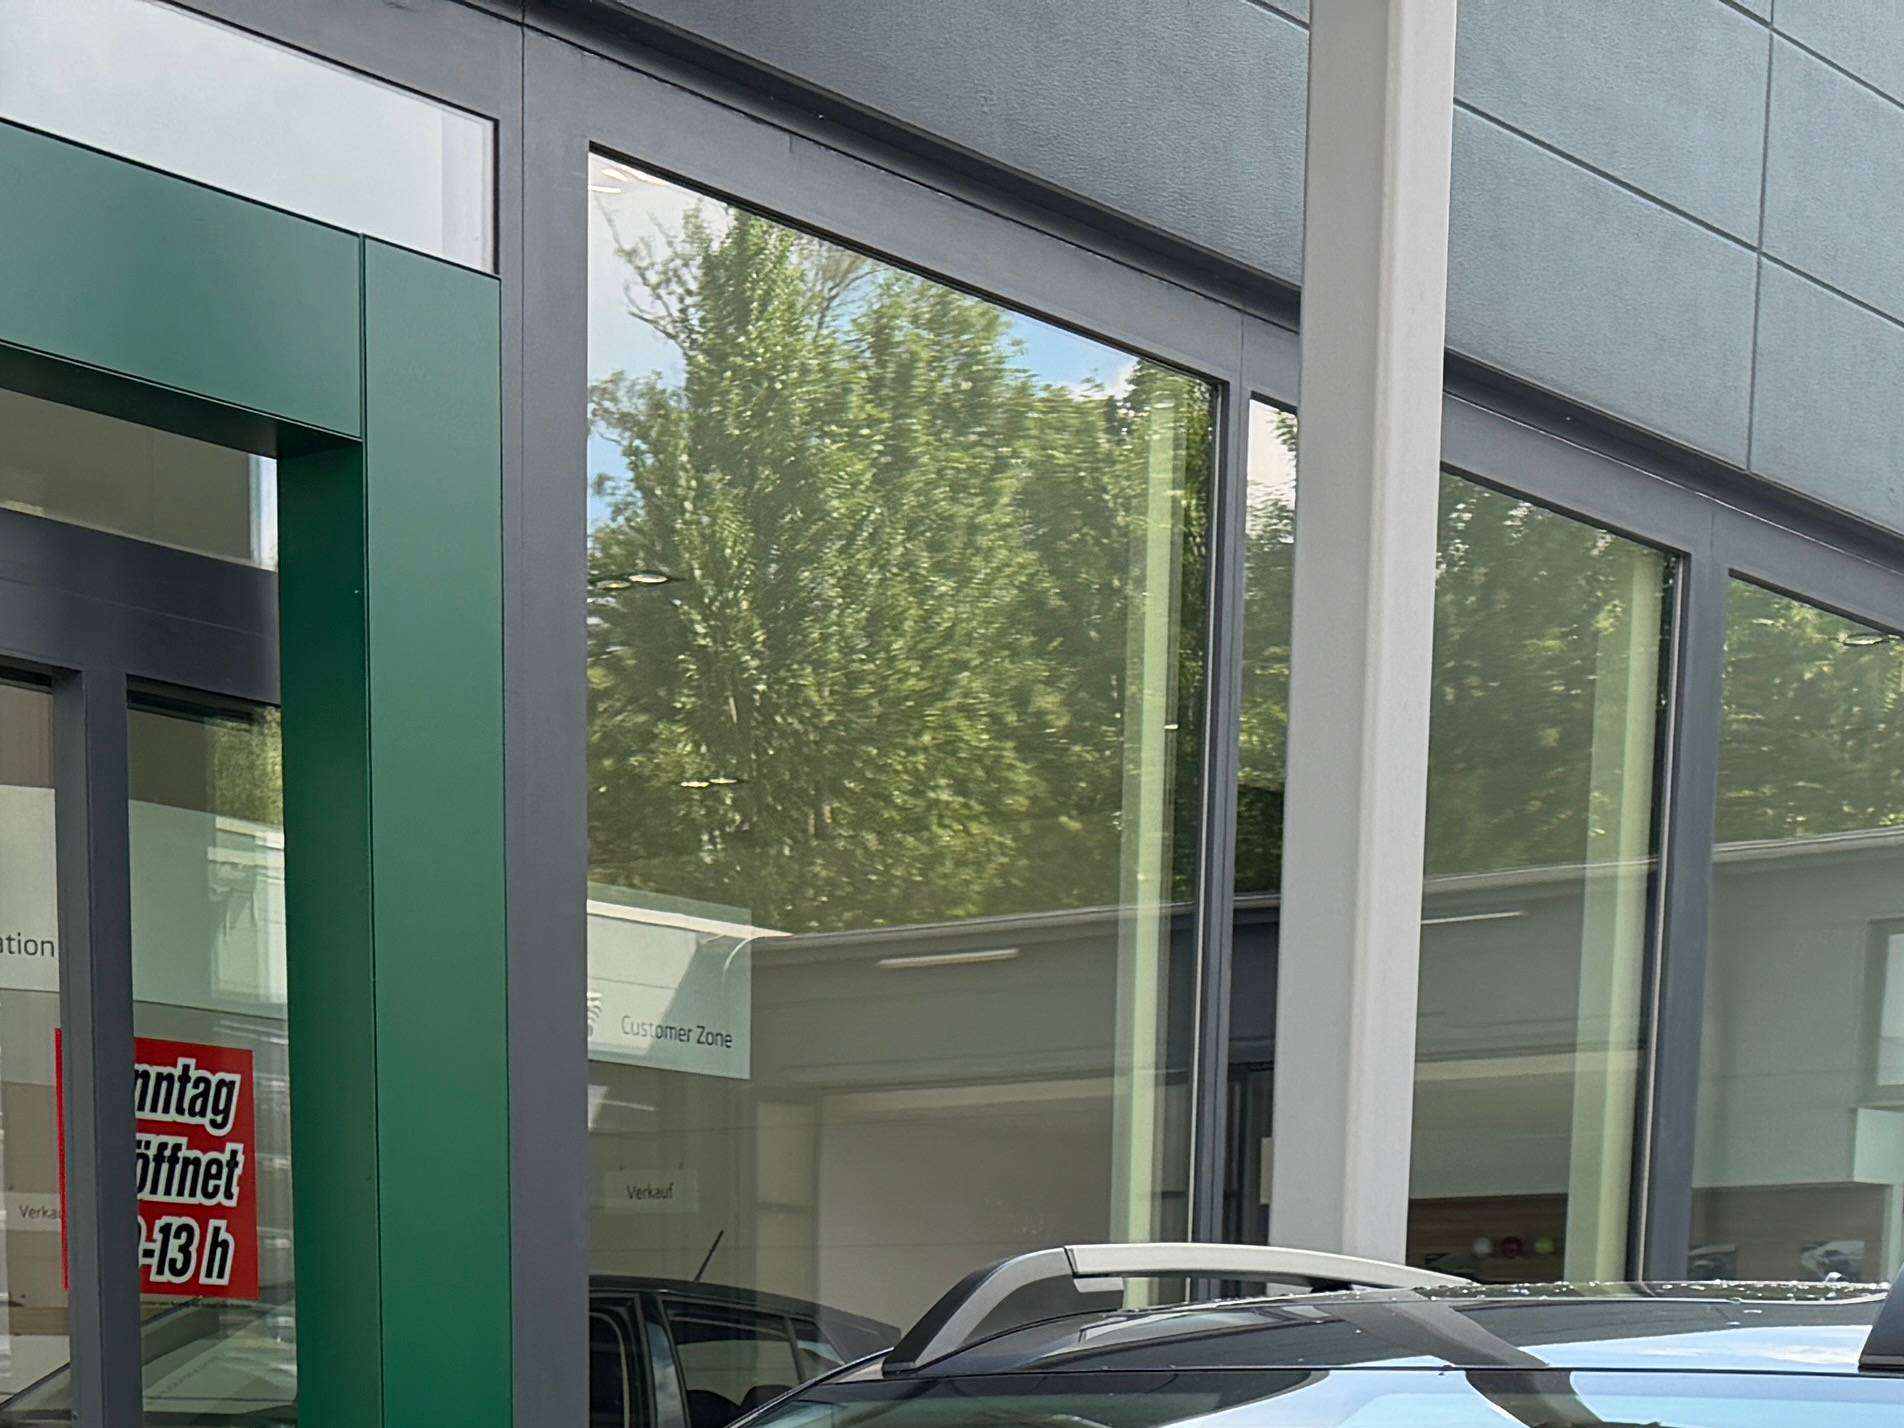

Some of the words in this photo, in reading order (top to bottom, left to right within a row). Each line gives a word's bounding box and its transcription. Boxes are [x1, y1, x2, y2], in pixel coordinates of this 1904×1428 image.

[621, 1015, 693, 1043] Customer
[696, 1025, 733, 1049] Zone
[135, 1061, 237, 1131] nntag
[136, 1138, 241, 1203] öffnet
[626, 1181, 675, 1200] Verkauf
[17, 1203, 60, 1220] Verka
